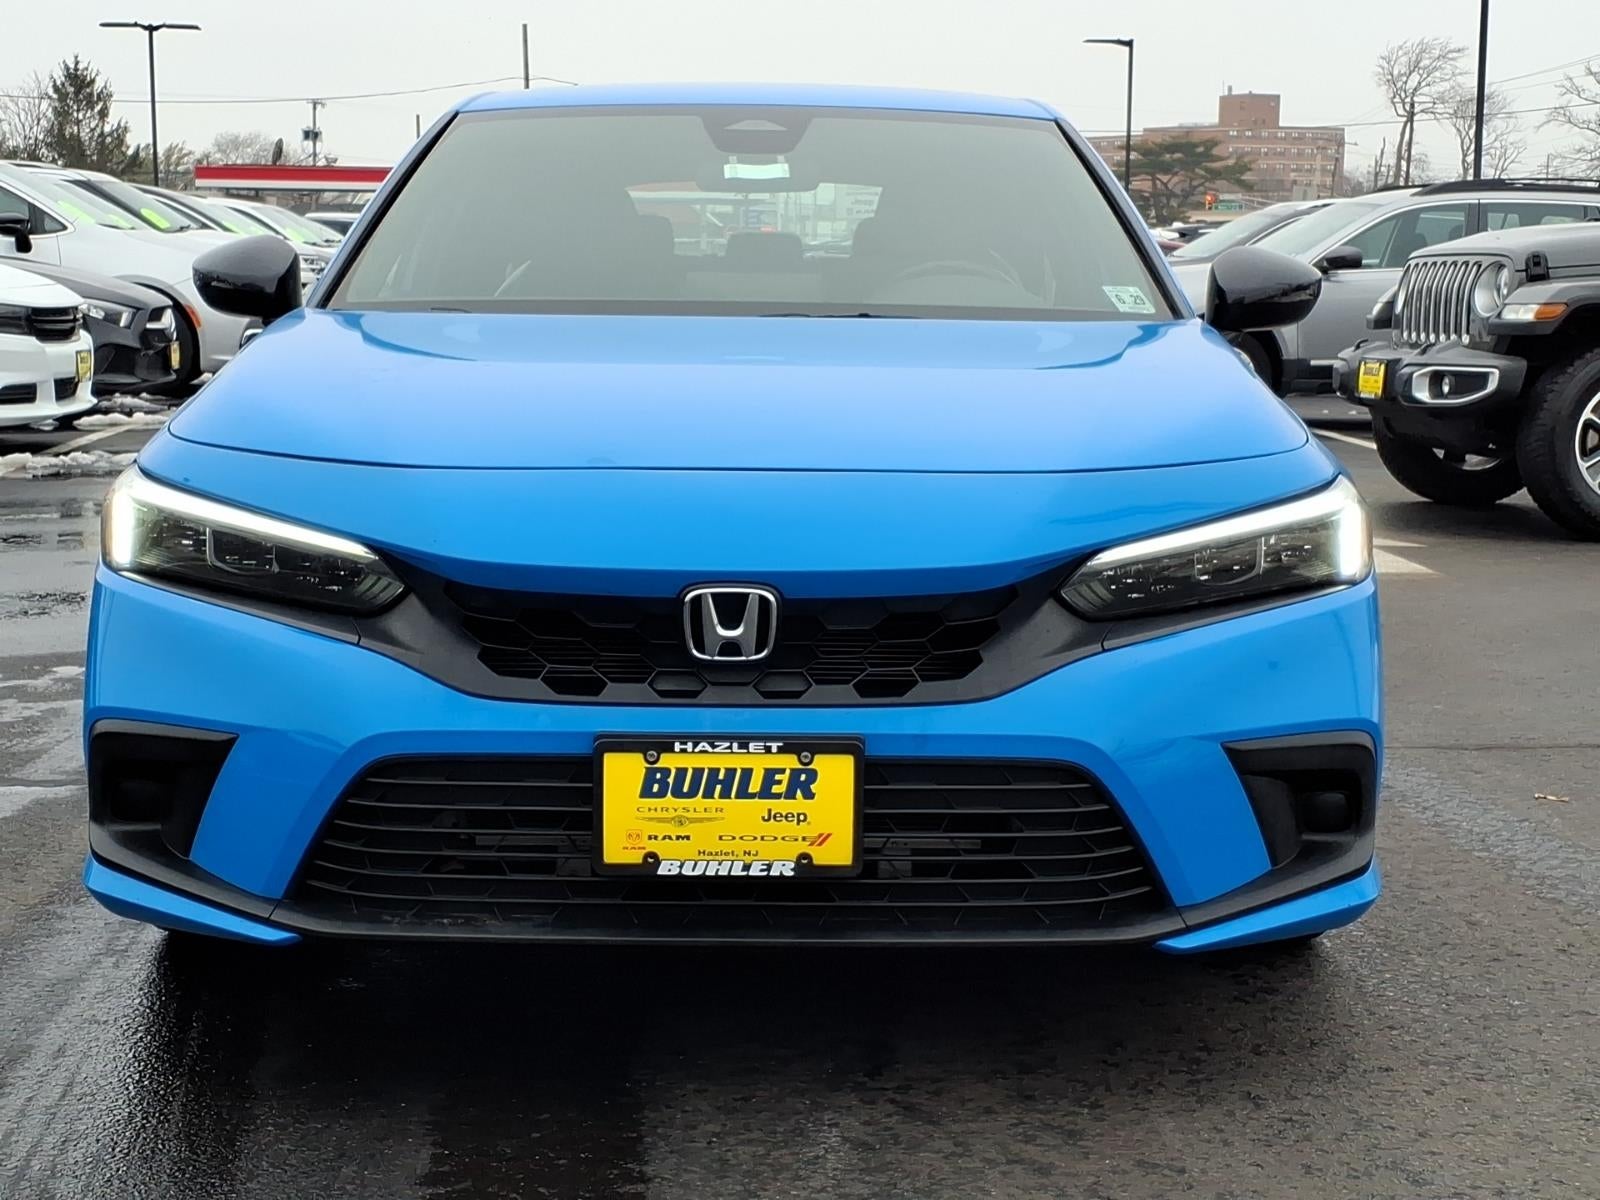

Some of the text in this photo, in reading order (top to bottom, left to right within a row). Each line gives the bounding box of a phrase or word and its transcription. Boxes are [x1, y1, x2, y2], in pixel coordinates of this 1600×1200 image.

[674, 741, 783, 753] HAZLET
[639, 766, 818, 801] BUHLER
[761, 808, 808, 826] Jeep
[718, 834, 816, 842] DODGE
[697, 849, 739, 857] Hazlet,
[657, 860, 795, 876] BUHLER
